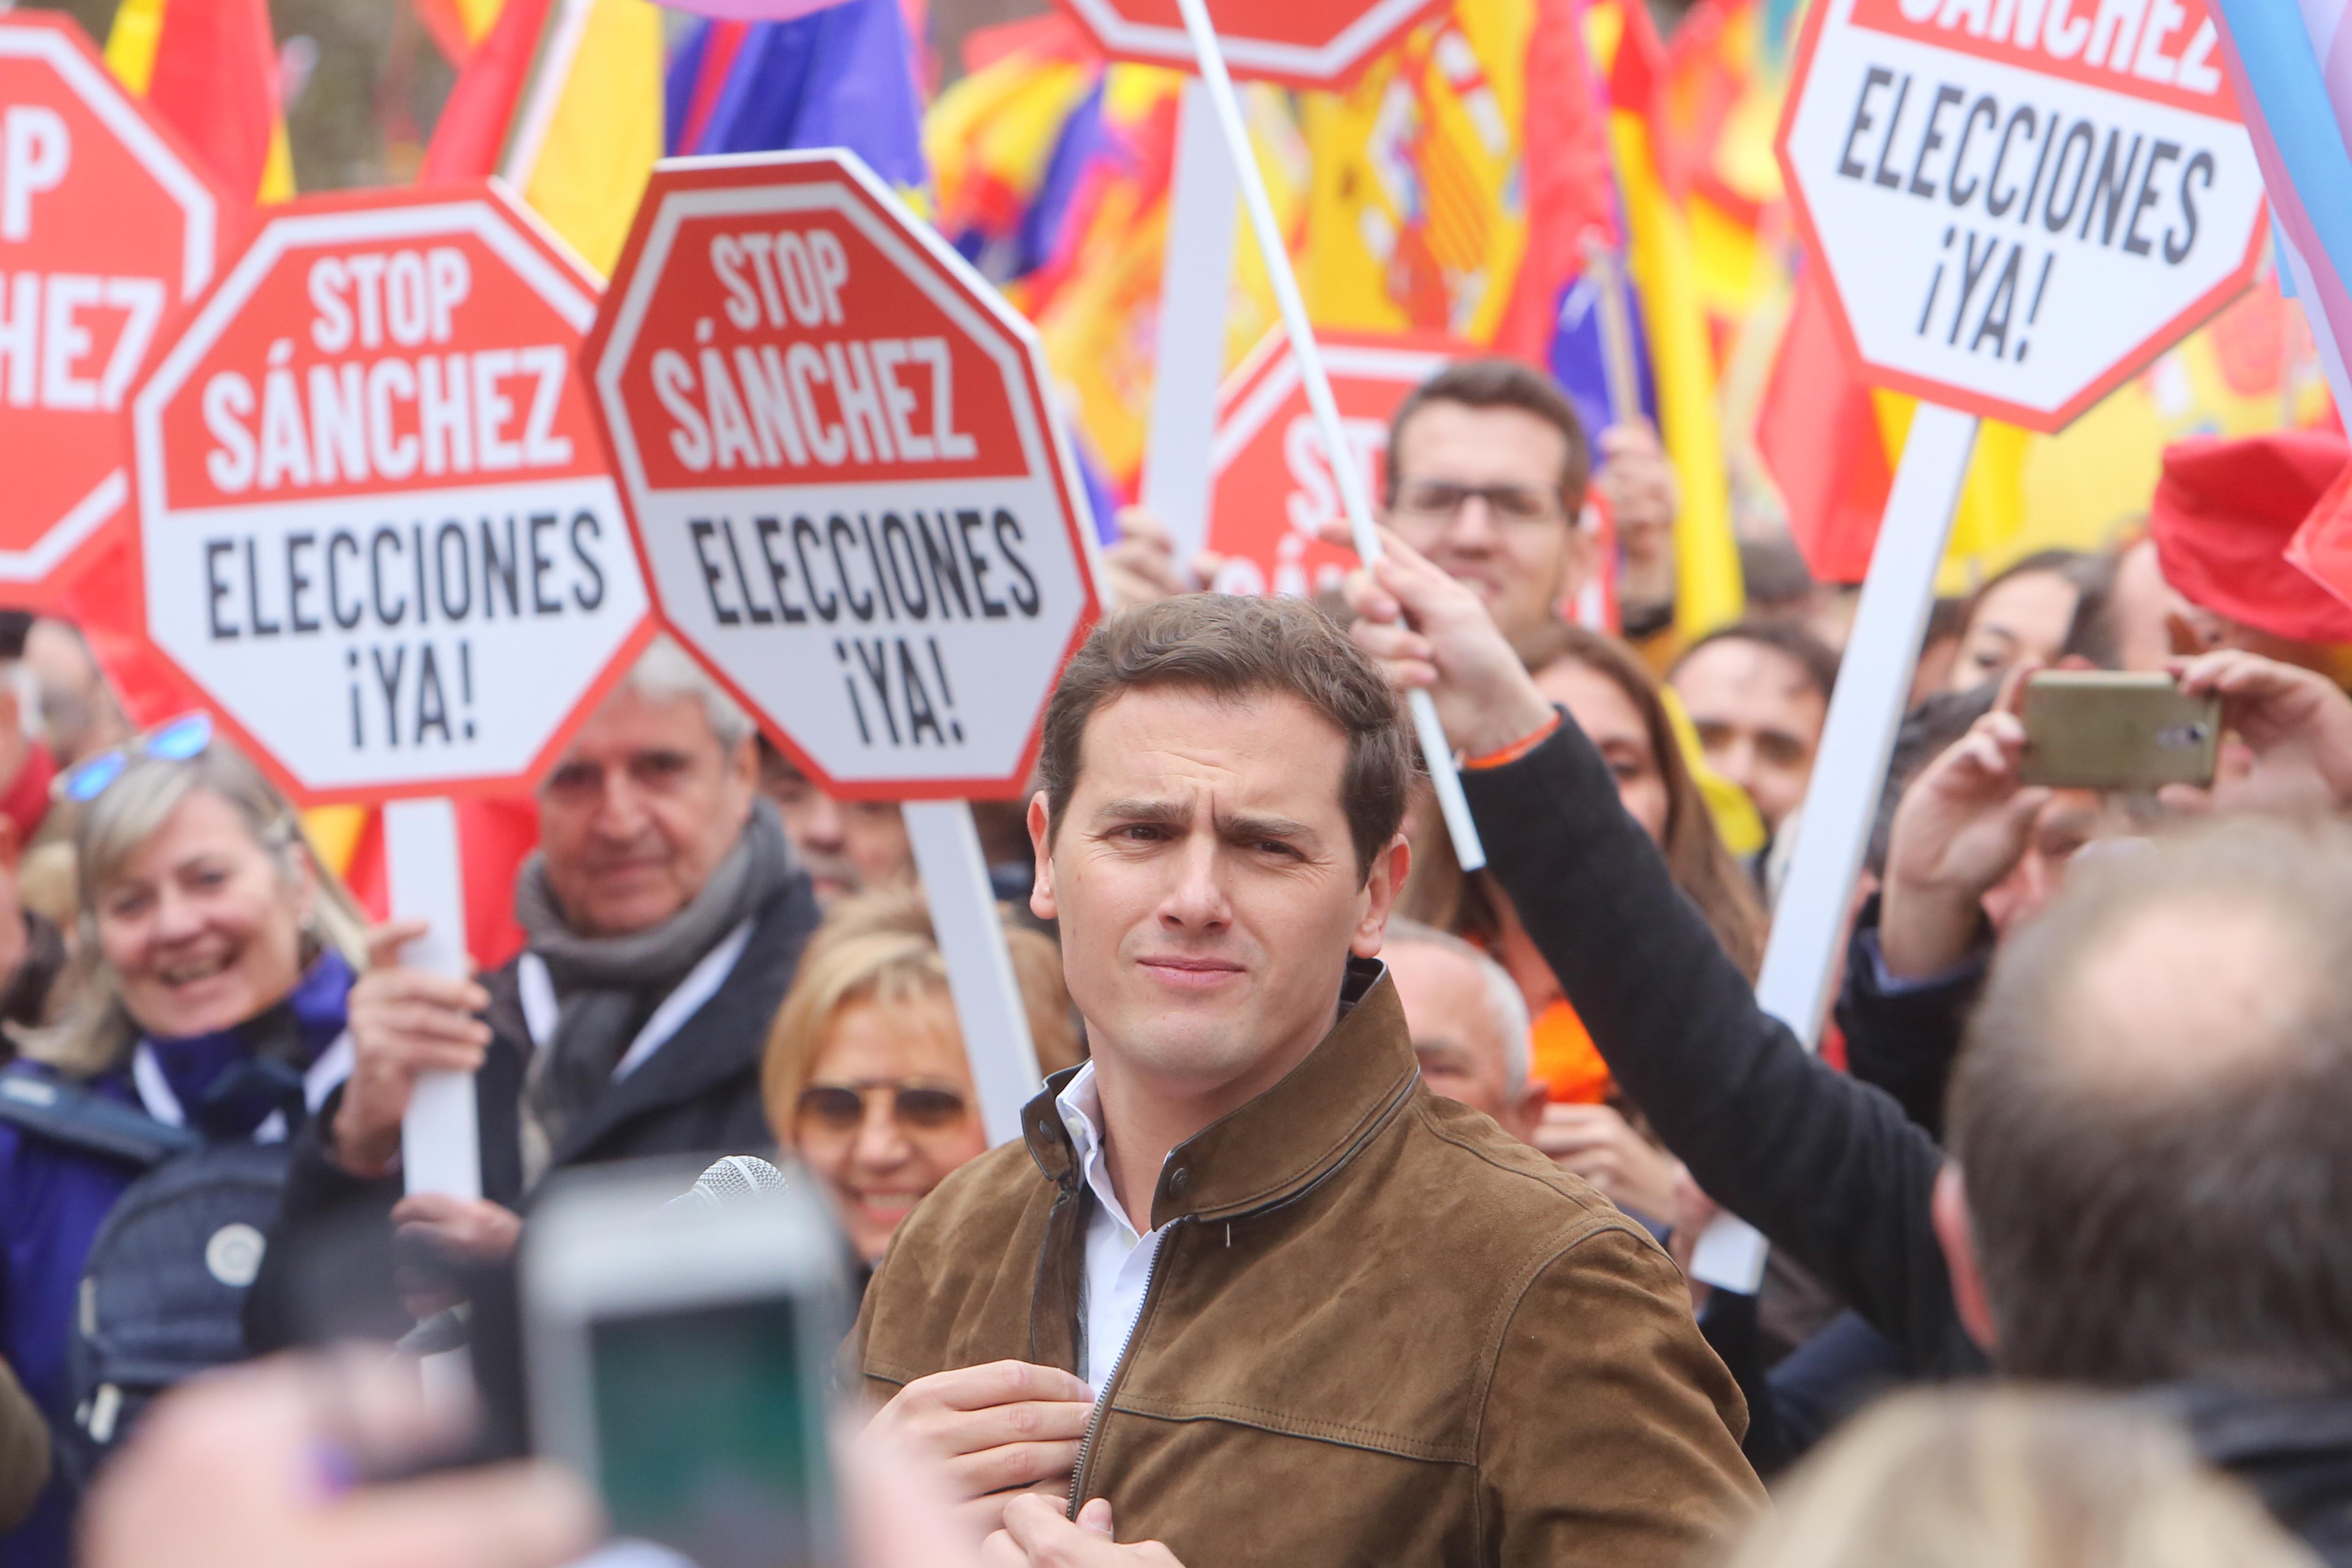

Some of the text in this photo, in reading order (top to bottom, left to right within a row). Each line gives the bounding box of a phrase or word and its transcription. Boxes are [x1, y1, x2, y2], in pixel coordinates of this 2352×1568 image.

[1837, 66, 2215, 265] ELECCIONES
[309, 248, 470, 351] STOP
[711, 230, 848, 330] STOP
[1918, 227, 2054, 362] ¡YA!
[204, 340, 572, 492] SÁNCHEZ
[652, 319, 977, 470] SÁNCHEZ
[206, 510, 604, 641] ELECCIONES
[689, 509, 1040, 626] ELECCIONES
[348, 642, 475, 748] ¡YA!
[835, 638, 963, 745] ¡YA!
